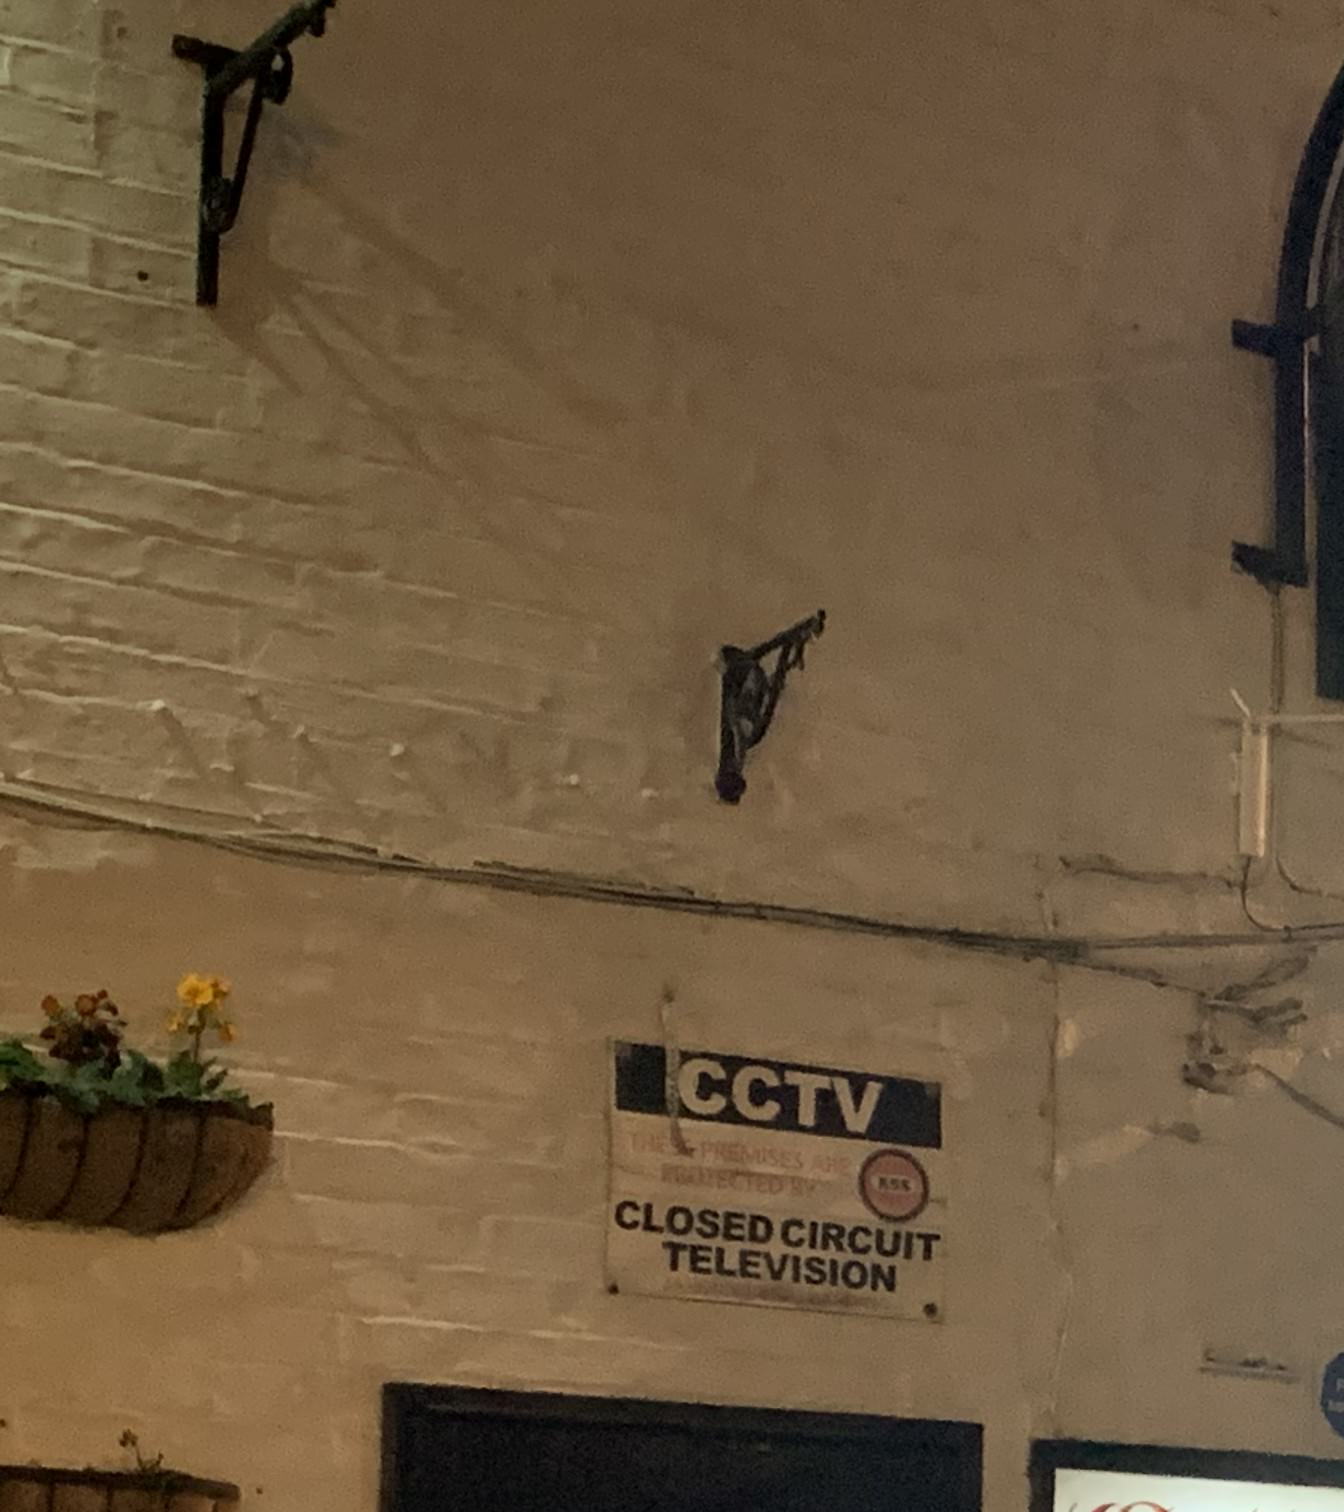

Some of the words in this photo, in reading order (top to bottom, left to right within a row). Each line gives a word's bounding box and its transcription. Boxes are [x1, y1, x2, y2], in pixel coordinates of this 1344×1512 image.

[677, 1058, 883, 1134] CCTV
[615, 1200, 773, 1245] CLOSED
[781, 1218, 941, 1262] CIRCUIT
[662, 1241, 896, 1293] TELEVISION
